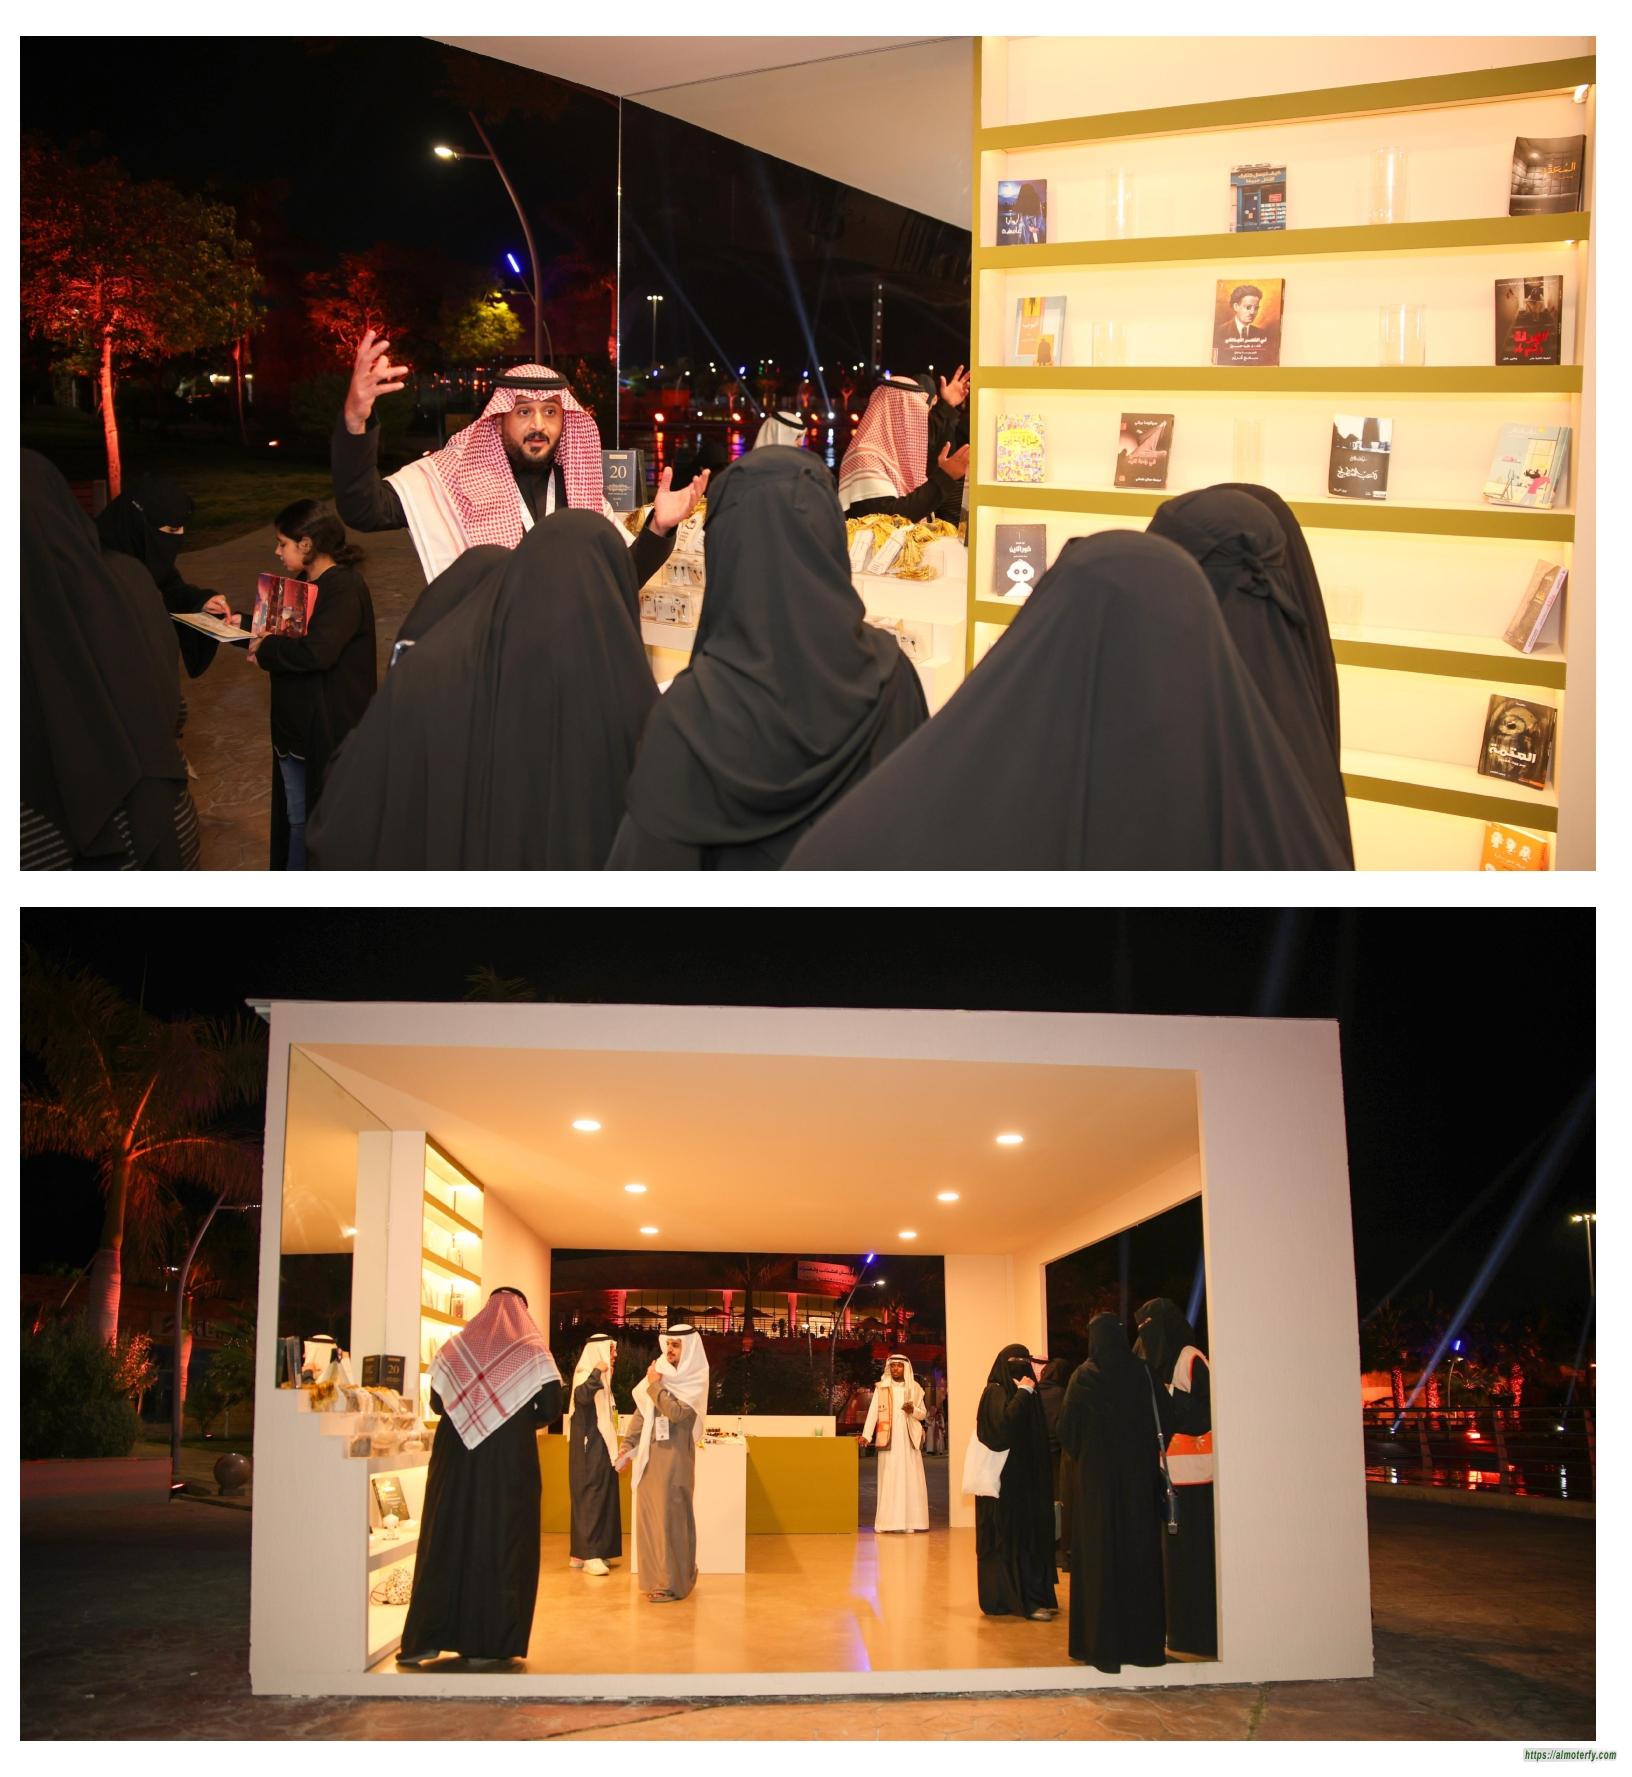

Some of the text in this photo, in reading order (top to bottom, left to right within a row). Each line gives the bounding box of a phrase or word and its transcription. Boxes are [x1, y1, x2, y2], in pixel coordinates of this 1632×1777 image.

[609, 465, 627, 479] 20
[1488, 743, 1537, 764] العتمة
[387, 1364, 400, 1375] 20
